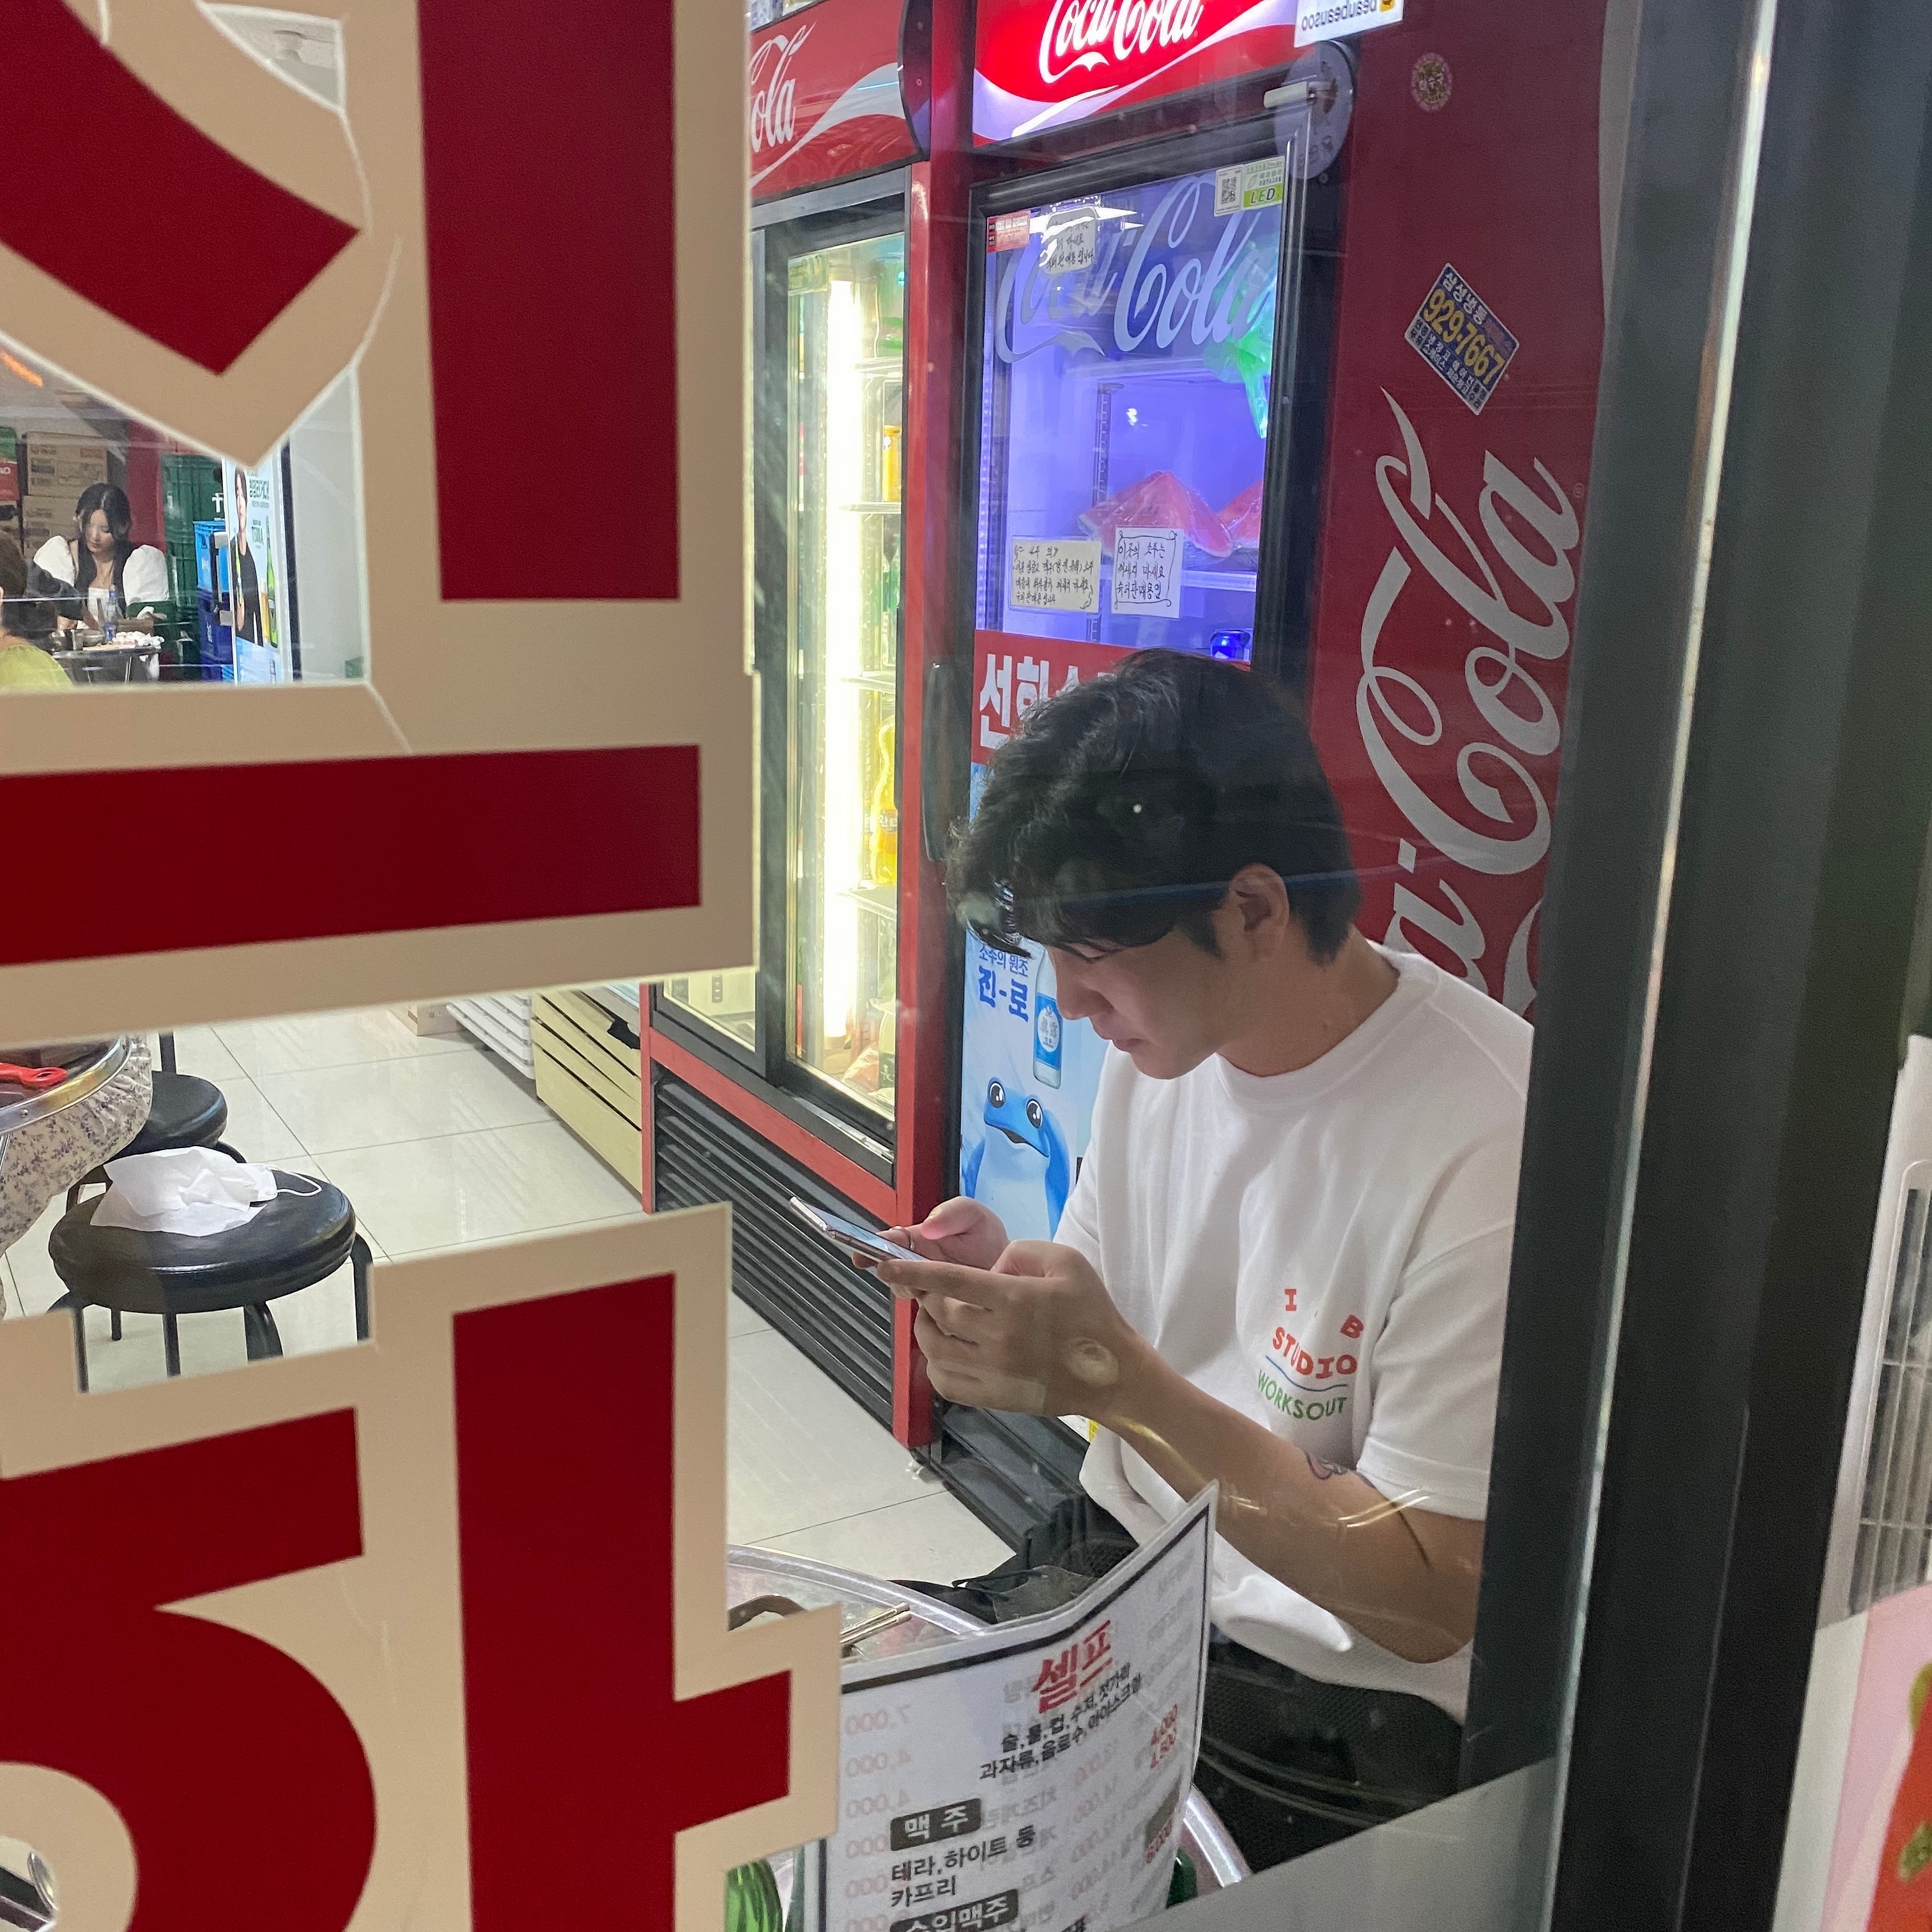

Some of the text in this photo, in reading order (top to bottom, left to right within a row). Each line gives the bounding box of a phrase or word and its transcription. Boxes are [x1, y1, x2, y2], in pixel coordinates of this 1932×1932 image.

[1039, 0, 1204, 84] CocaCola
[1250, 188, 1275, 204] LED
[1442, 272, 1487, 325] 삼성냉동
[1142, 560, 1165, 580] 마세요
[1009, 954, 1029, 977] 원조
[1272, 1326, 1358, 1379] STUDIO
[1257, 1368, 1347, 1421] WORKSOUT
[1031, 1620, 1113, 1714] 셀프
[891, 1874, 956, 1908] 카프리
